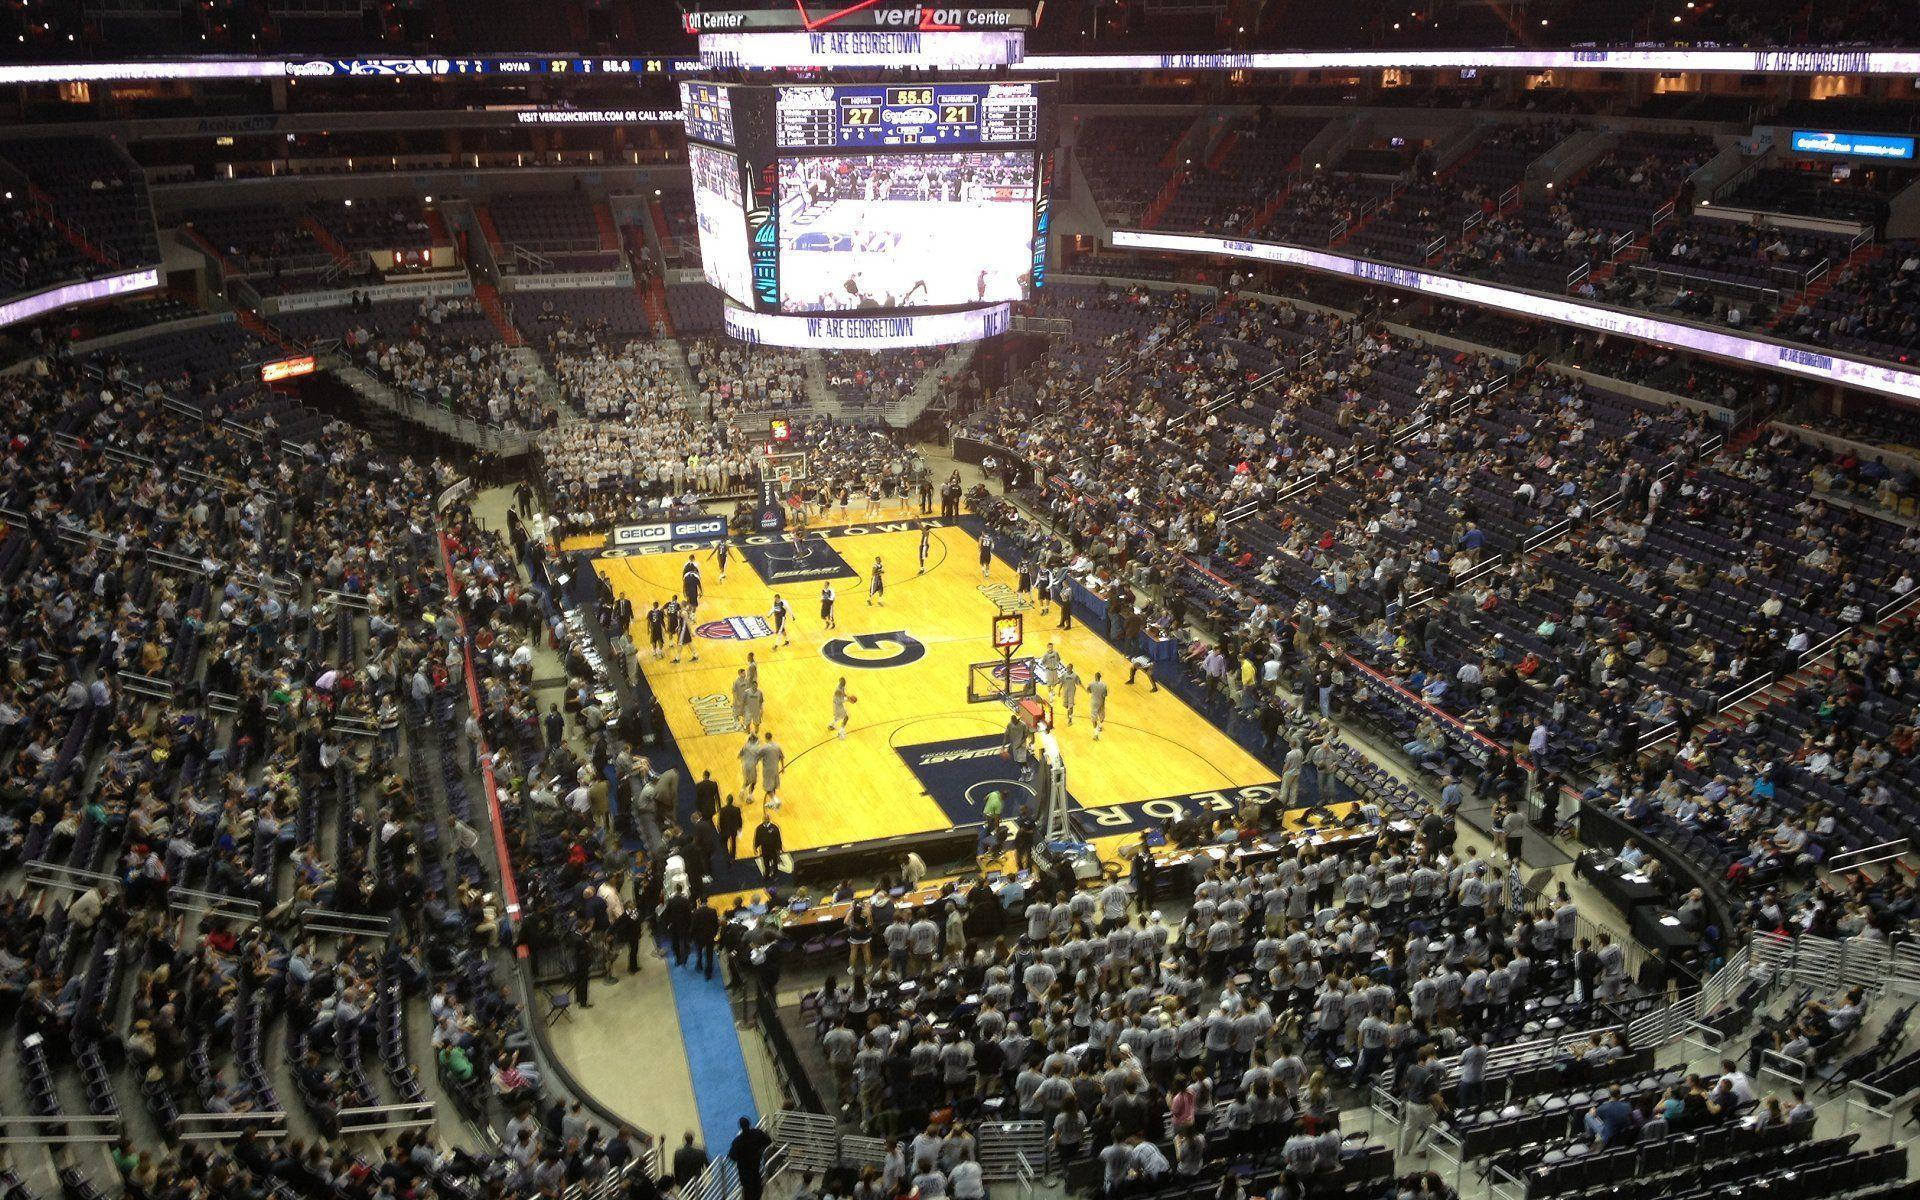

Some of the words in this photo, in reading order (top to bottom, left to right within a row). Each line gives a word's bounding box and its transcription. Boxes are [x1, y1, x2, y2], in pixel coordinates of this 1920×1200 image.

[703, 14, 744, 28] Center
[874, 4, 961, 31] verizon
[966, 9, 1011, 25] Center
[809, 32, 827, 54] WE
[830, 32, 849, 54] ARE
[851, 31, 922, 54] GEORGETOWN
[499, 62, 531, 72] HOYAS
[551, 60, 568, 72] 27
[646, 60, 662, 72] 21
[897, 90, 932, 105] 55.6
[517, 112, 538, 122] VISIT
[539, 111, 624, 122] VERIZONCENTER.COM
[625, 111, 637, 121] OR
[639, 111, 658, 121] CALL
[848, 108, 874, 125] 27
[945, 106, 968, 123] 21
[807, 318, 822, 337] WE
[826, 318, 844, 338] ARE
[846, 317, 914, 338] GEORGETOWN
[620, 527, 666, 539] GEICO
[675, 521, 721, 535] GEICO
